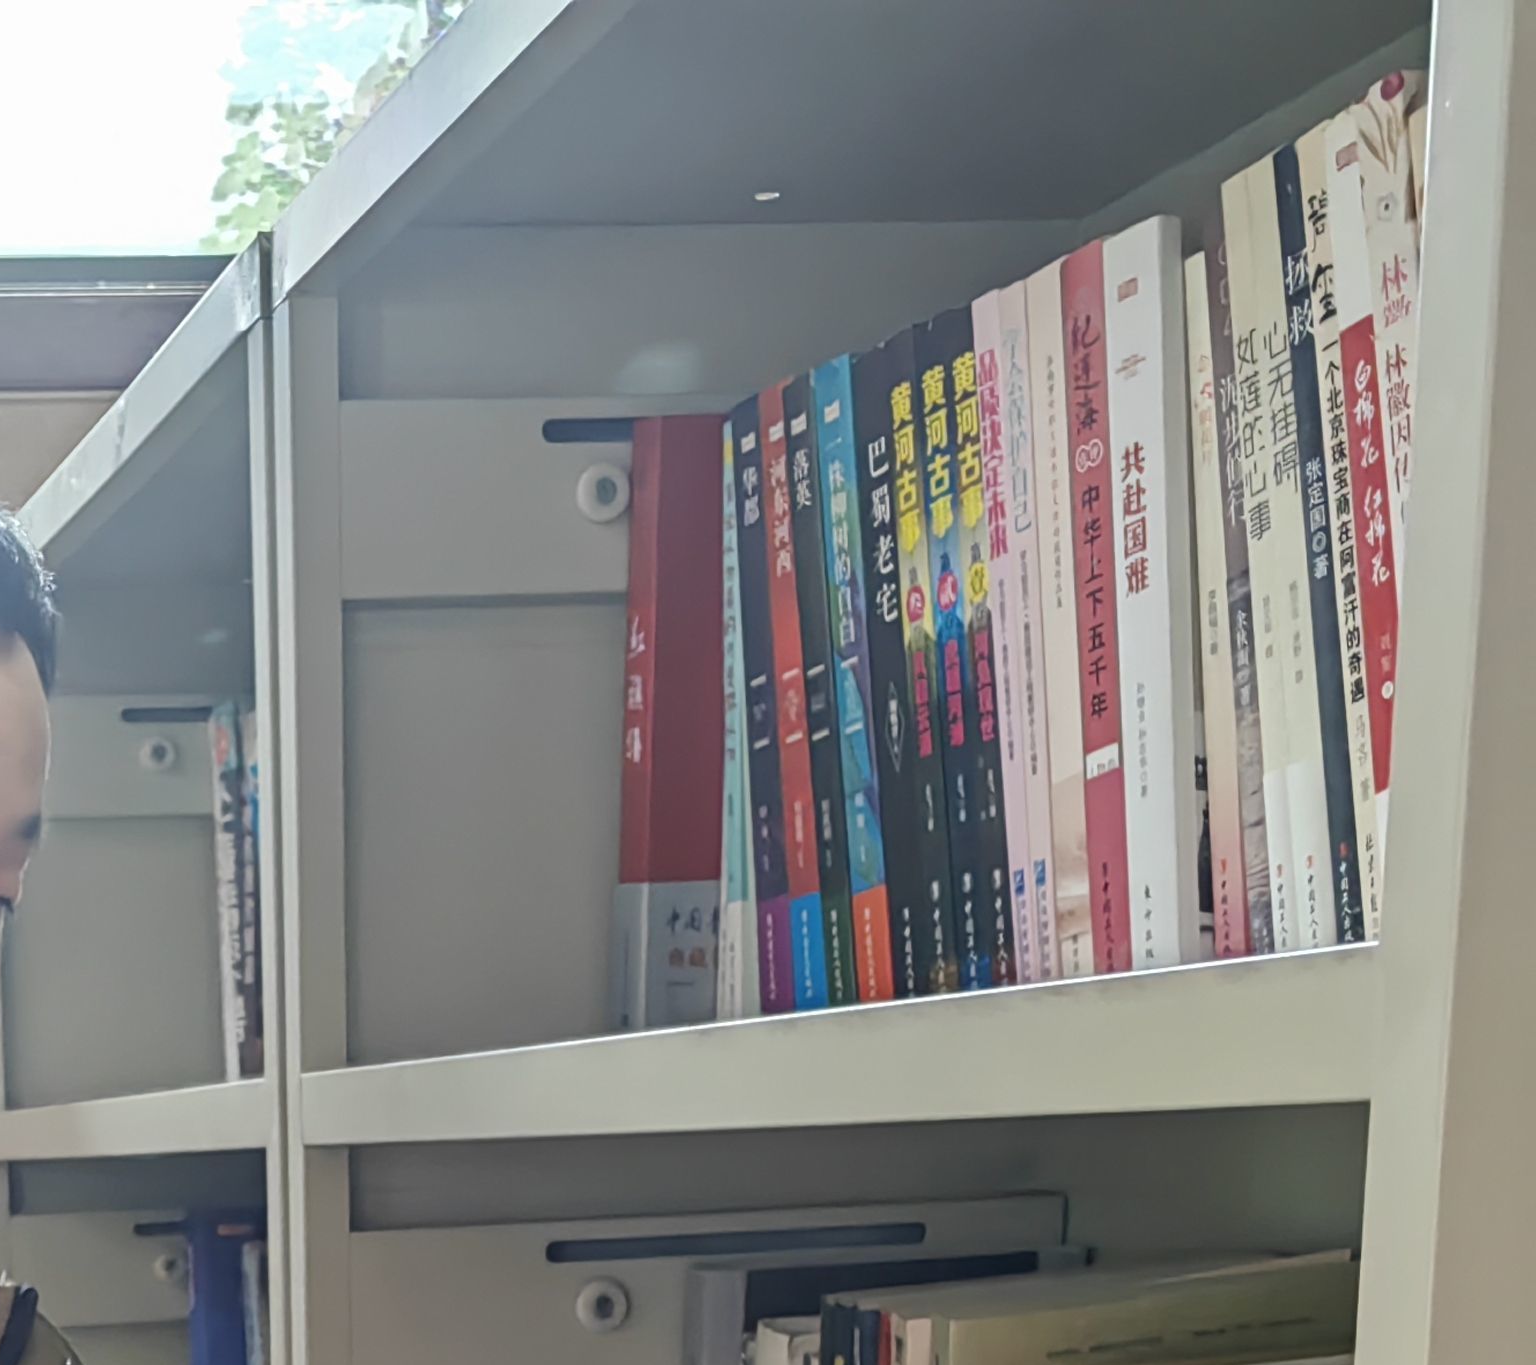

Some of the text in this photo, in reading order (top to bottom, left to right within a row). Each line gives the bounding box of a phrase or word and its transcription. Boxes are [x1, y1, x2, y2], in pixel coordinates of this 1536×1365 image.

[1285, 249, 1314, 345] 拯救
[793, 449, 812, 510] 落英
[1237, 328, 1271, 541] 如莲的心事
[1263, 321, 1299, 493] 心无挂碍
[1354, 360, 1390, 586] 白棉花 红棉花
[868, 436, 898, 622] 巴蜀老宅
[1081, 484, 1109, 719] 中华上下五千年
[1121, 441, 1149, 598] 共赴国难
[1321, 338, 1365, 704] 一个北京珠宝商在阿富汗的奇遇
